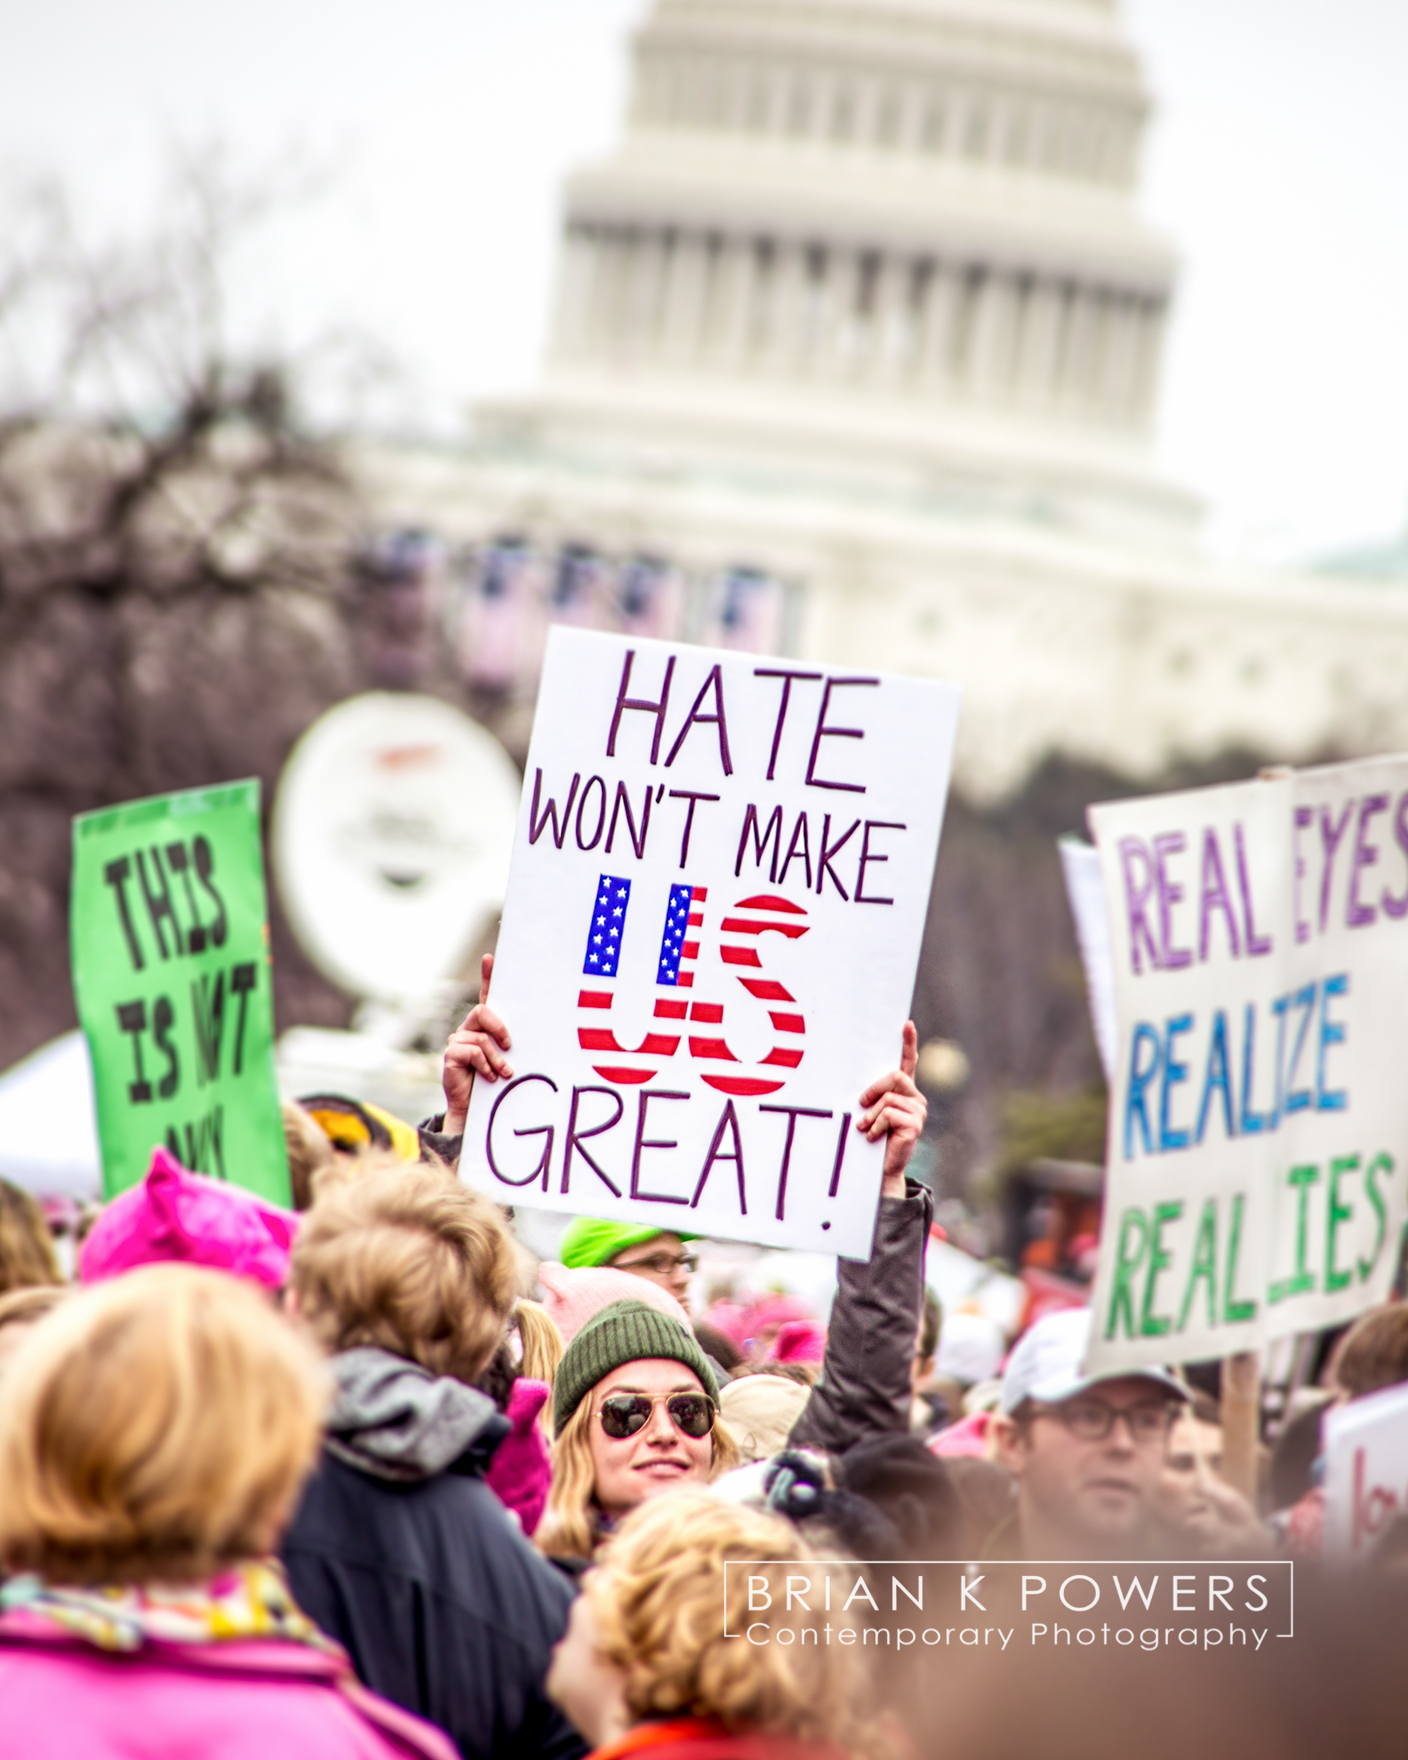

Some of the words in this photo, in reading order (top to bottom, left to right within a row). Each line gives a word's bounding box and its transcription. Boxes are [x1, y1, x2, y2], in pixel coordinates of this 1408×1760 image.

[606, 650, 881, 794] HATE
[105, 833, 229, 973] THIS
[529, 768, 721, 868] WON'T
[735, 804, 907, 905] MAKE
[1117, 820, 1272, 975] REAL
[1294, 790, 1408, 946] EYES
[115, 996, 181, 1106] IS
[577, 873, 811, 1096] US
[1123, 973, 1350, 1161] REALIZE
[485, 1074, 853, 1230] GREAT!
[1105, 1192, 1257, 1341] REAL
[1267, 1151, 1395, 1305] LIES
